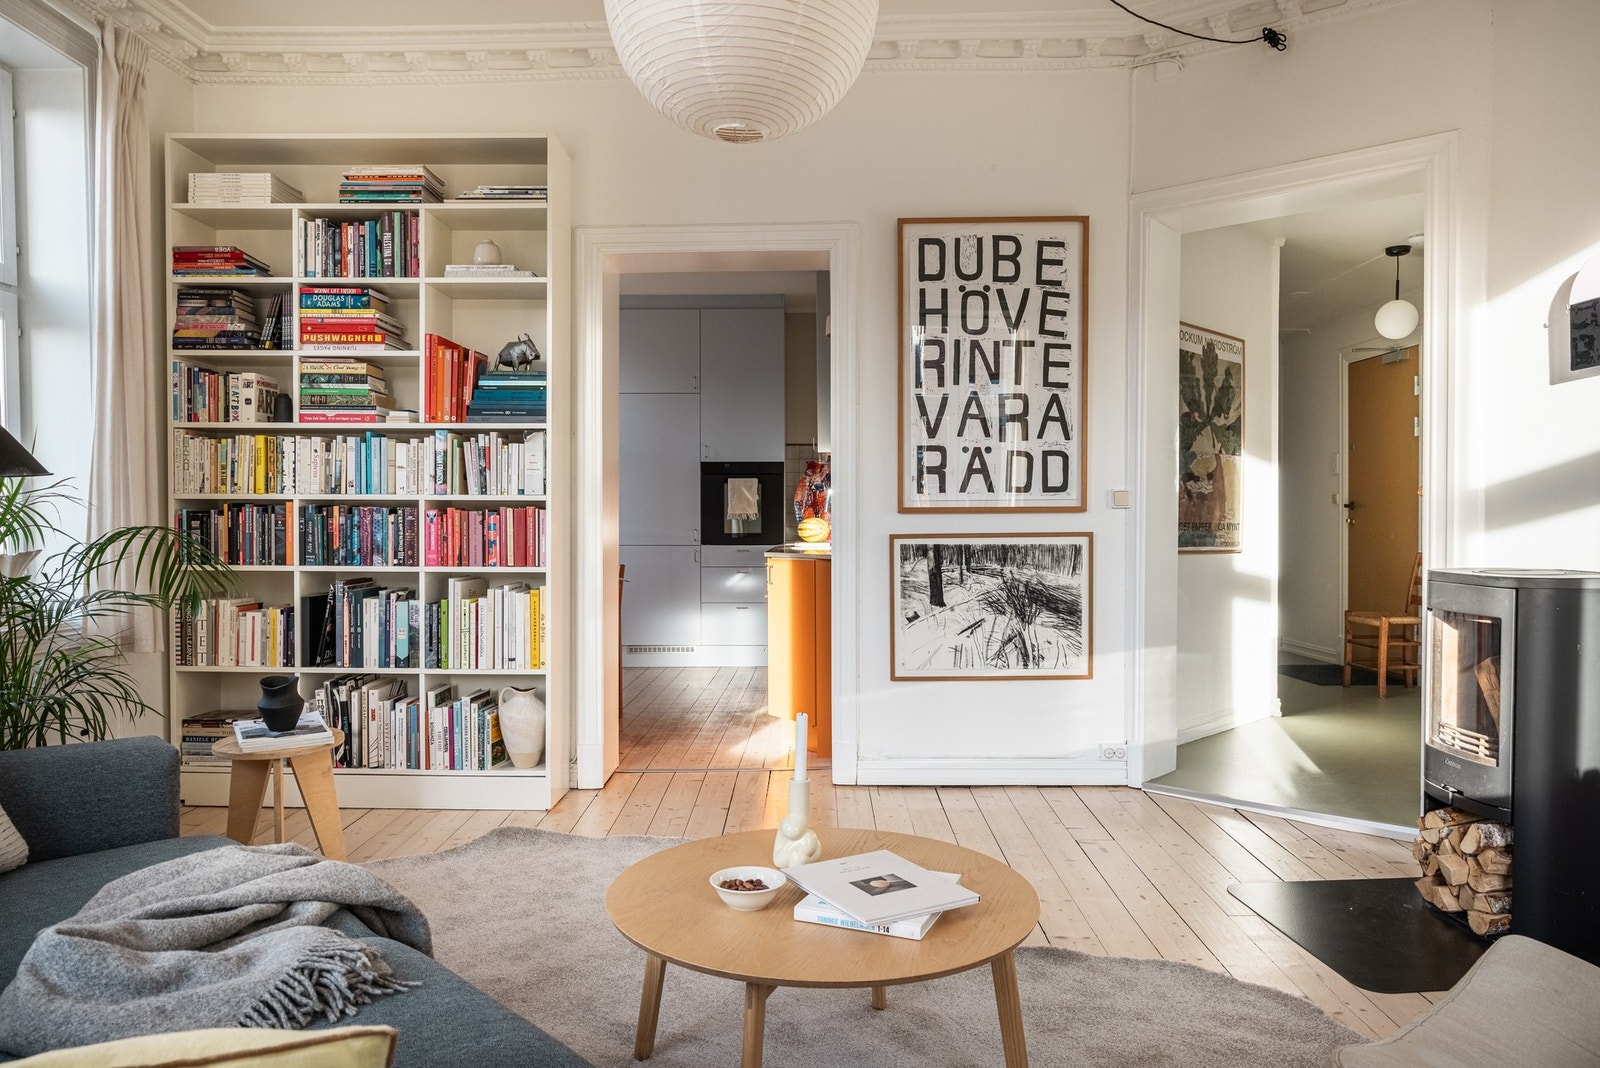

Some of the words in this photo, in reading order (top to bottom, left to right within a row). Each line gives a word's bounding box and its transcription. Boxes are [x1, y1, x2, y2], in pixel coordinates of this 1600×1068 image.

[383, 232, 392, 257] PALESTINA
[918, 235, 1066, 287] DUBE
[918, 285, 1070, 338] HÖVE
[303, 334, 373, 342] PUSHWAGNER
[1204, 336, 1242, 356] NRDSTRÖM
[231, 405, 240, 422] BOX
[915, 391, 1071, 442] VARA
[312, 454, 320, 478] Sapiens
[916, 445, 1070, 494] RÄDD
[817, 915, 839, 926] TOMMIE
